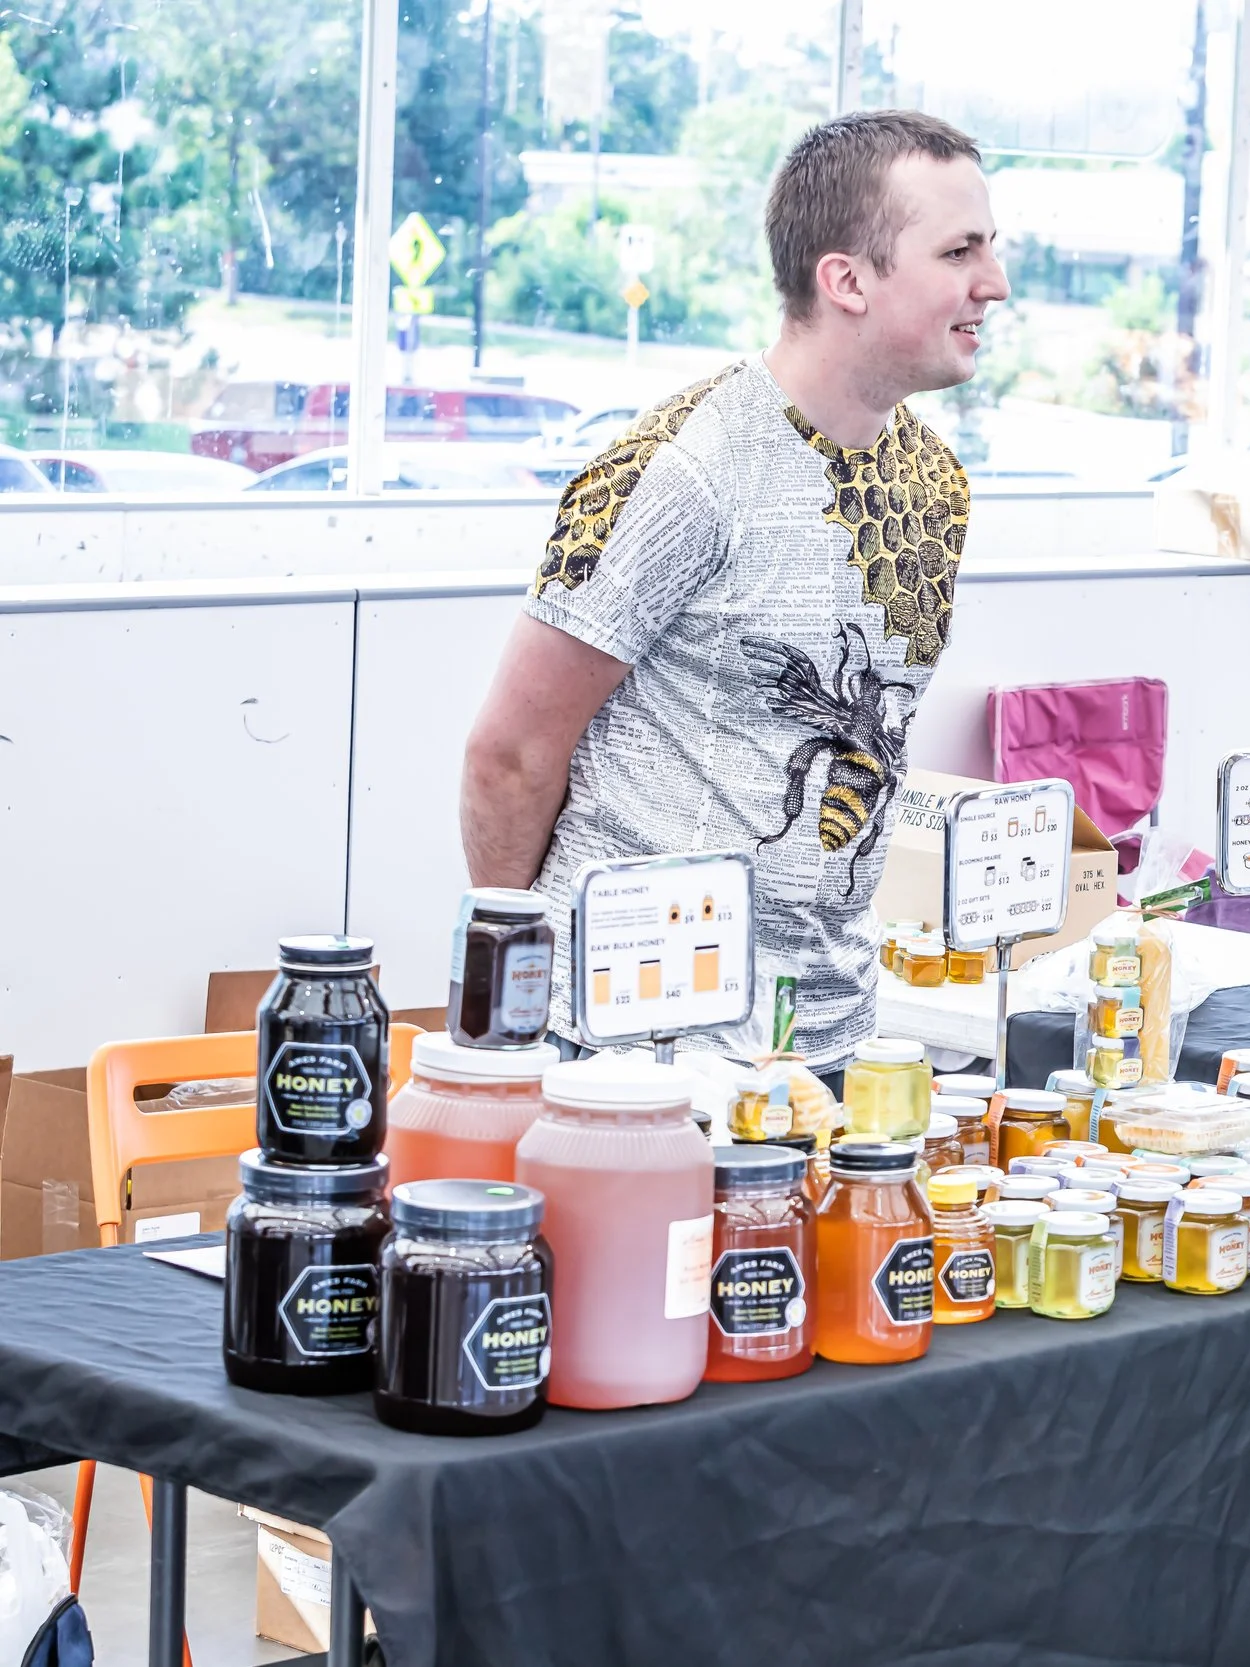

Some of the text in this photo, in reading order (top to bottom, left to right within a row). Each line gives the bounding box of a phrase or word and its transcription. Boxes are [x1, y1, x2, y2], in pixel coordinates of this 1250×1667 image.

[994, 794, 1032, 806] RAW HONEY
[900, 809, 926, 826] THIS
[960, 814, 977, 822] SINGLE
[1020, 828, 1031, 836] $12
[1047, 824, 1058, 832] $20
[990, 833, 998, 842] $5
[1040, 870, 1050, 878] $22
[1083, 870, 1094, 879] 375
[998, 876, 1010, 886] $12
[1076, 881, 1104, 892] OVAL HEX
[593, 886, 650, 897] TABLE HONEY
[1042, 902, 1052, 912] $22
[983, 914, 992, 924] $14
[591, 938, 666, 952] RAW BULK HONEY
[276, 1073, 358, 1094] HONEY
[1219, 1241, 1245, 1254] HONEY
[949, 1266, 991, 1279] HONEY
[717, 1278, 794, 1297] HONEY
[297, 1296, 376, 1315] HONEY
[482, 1326, 548, 1350] HONEY
